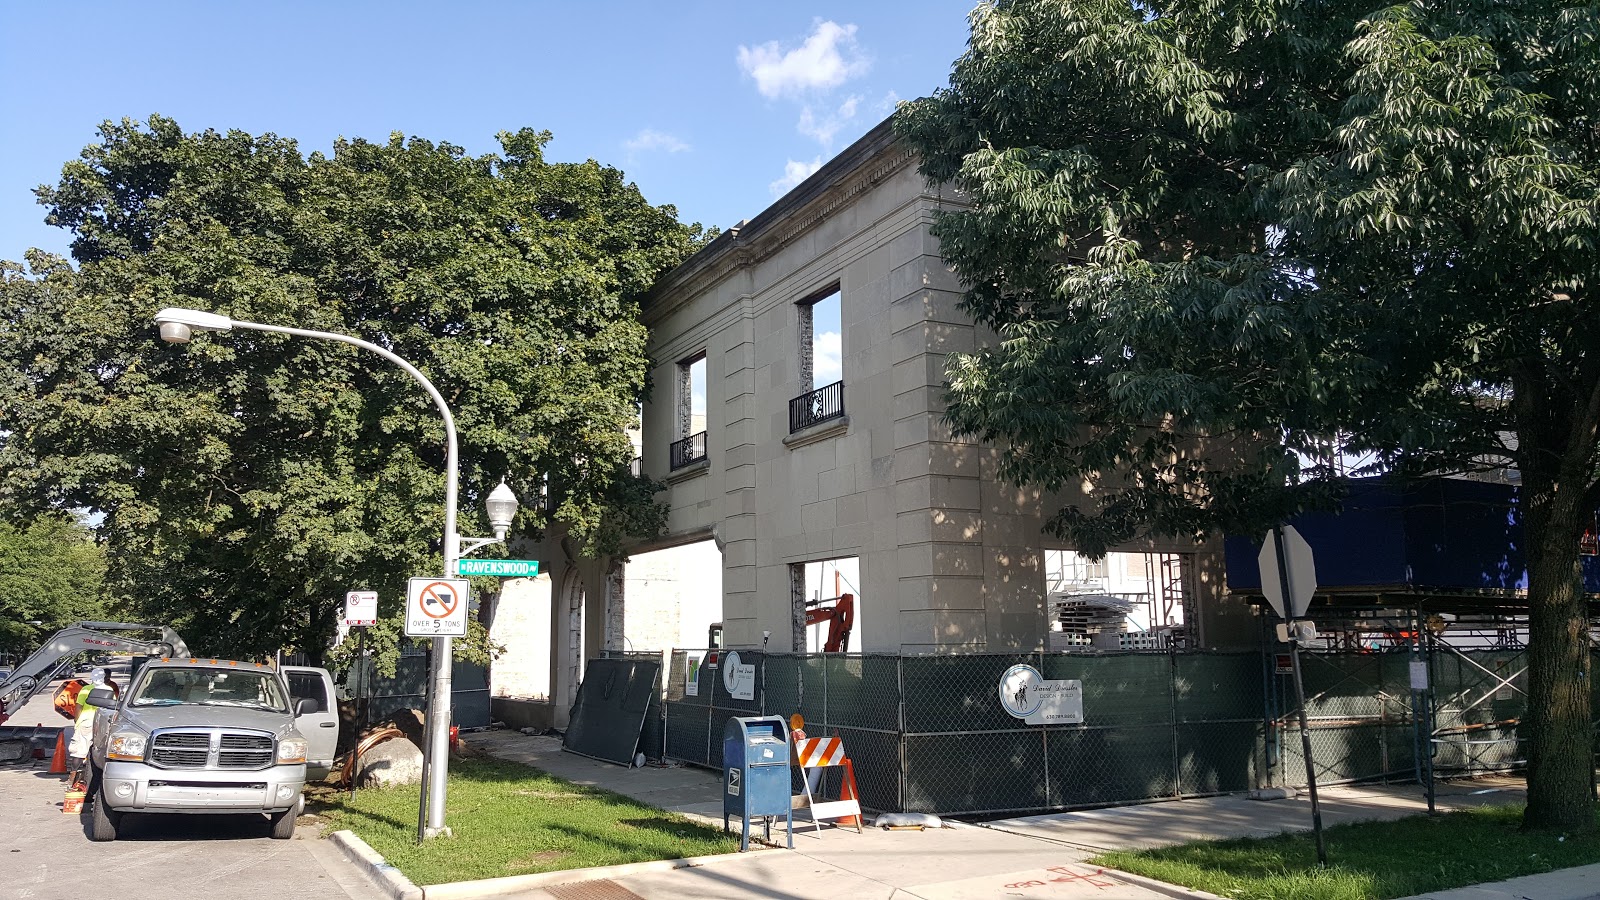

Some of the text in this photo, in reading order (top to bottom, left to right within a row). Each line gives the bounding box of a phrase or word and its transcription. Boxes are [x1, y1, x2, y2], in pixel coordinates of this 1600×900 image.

[466, 561, 529, 575] RAVENSWOOD
[412, 619, 461, 629] OVER 5 TONS
[82, 637, 118, 648] TAKEUCHI
